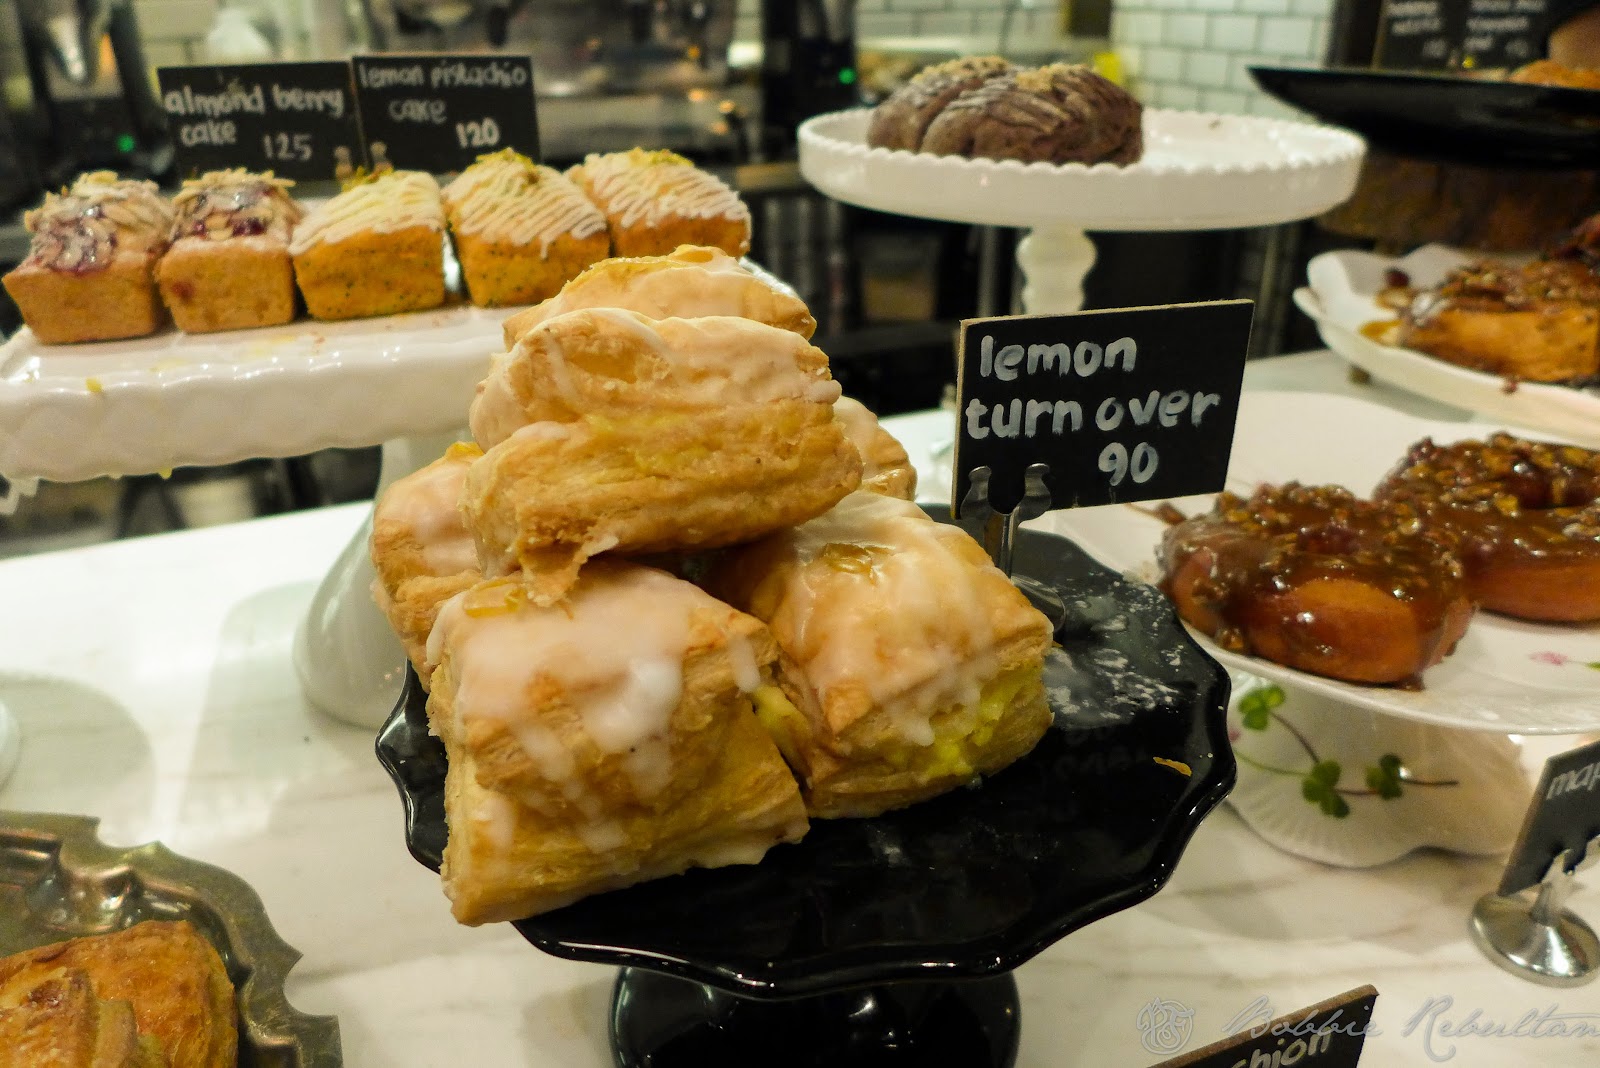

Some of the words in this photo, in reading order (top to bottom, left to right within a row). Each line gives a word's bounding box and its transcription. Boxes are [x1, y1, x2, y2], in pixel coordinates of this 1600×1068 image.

[359, 62, 424, 88] lemon
[164, 84, 265, 116] almond
[272, 83, 345, 120] berry
[387, 100, 448, 125] cake
[179, 119, 237, 147] cake
[263, 131, 312, 161] 125
[455, 117, 500, 149] 120
[979, 335, 1138, 381] lemon
[965, 398, 1084, 440] turn
[1095, 389, 1221, 432] over
[1098, 441, 1160, 486] 90
